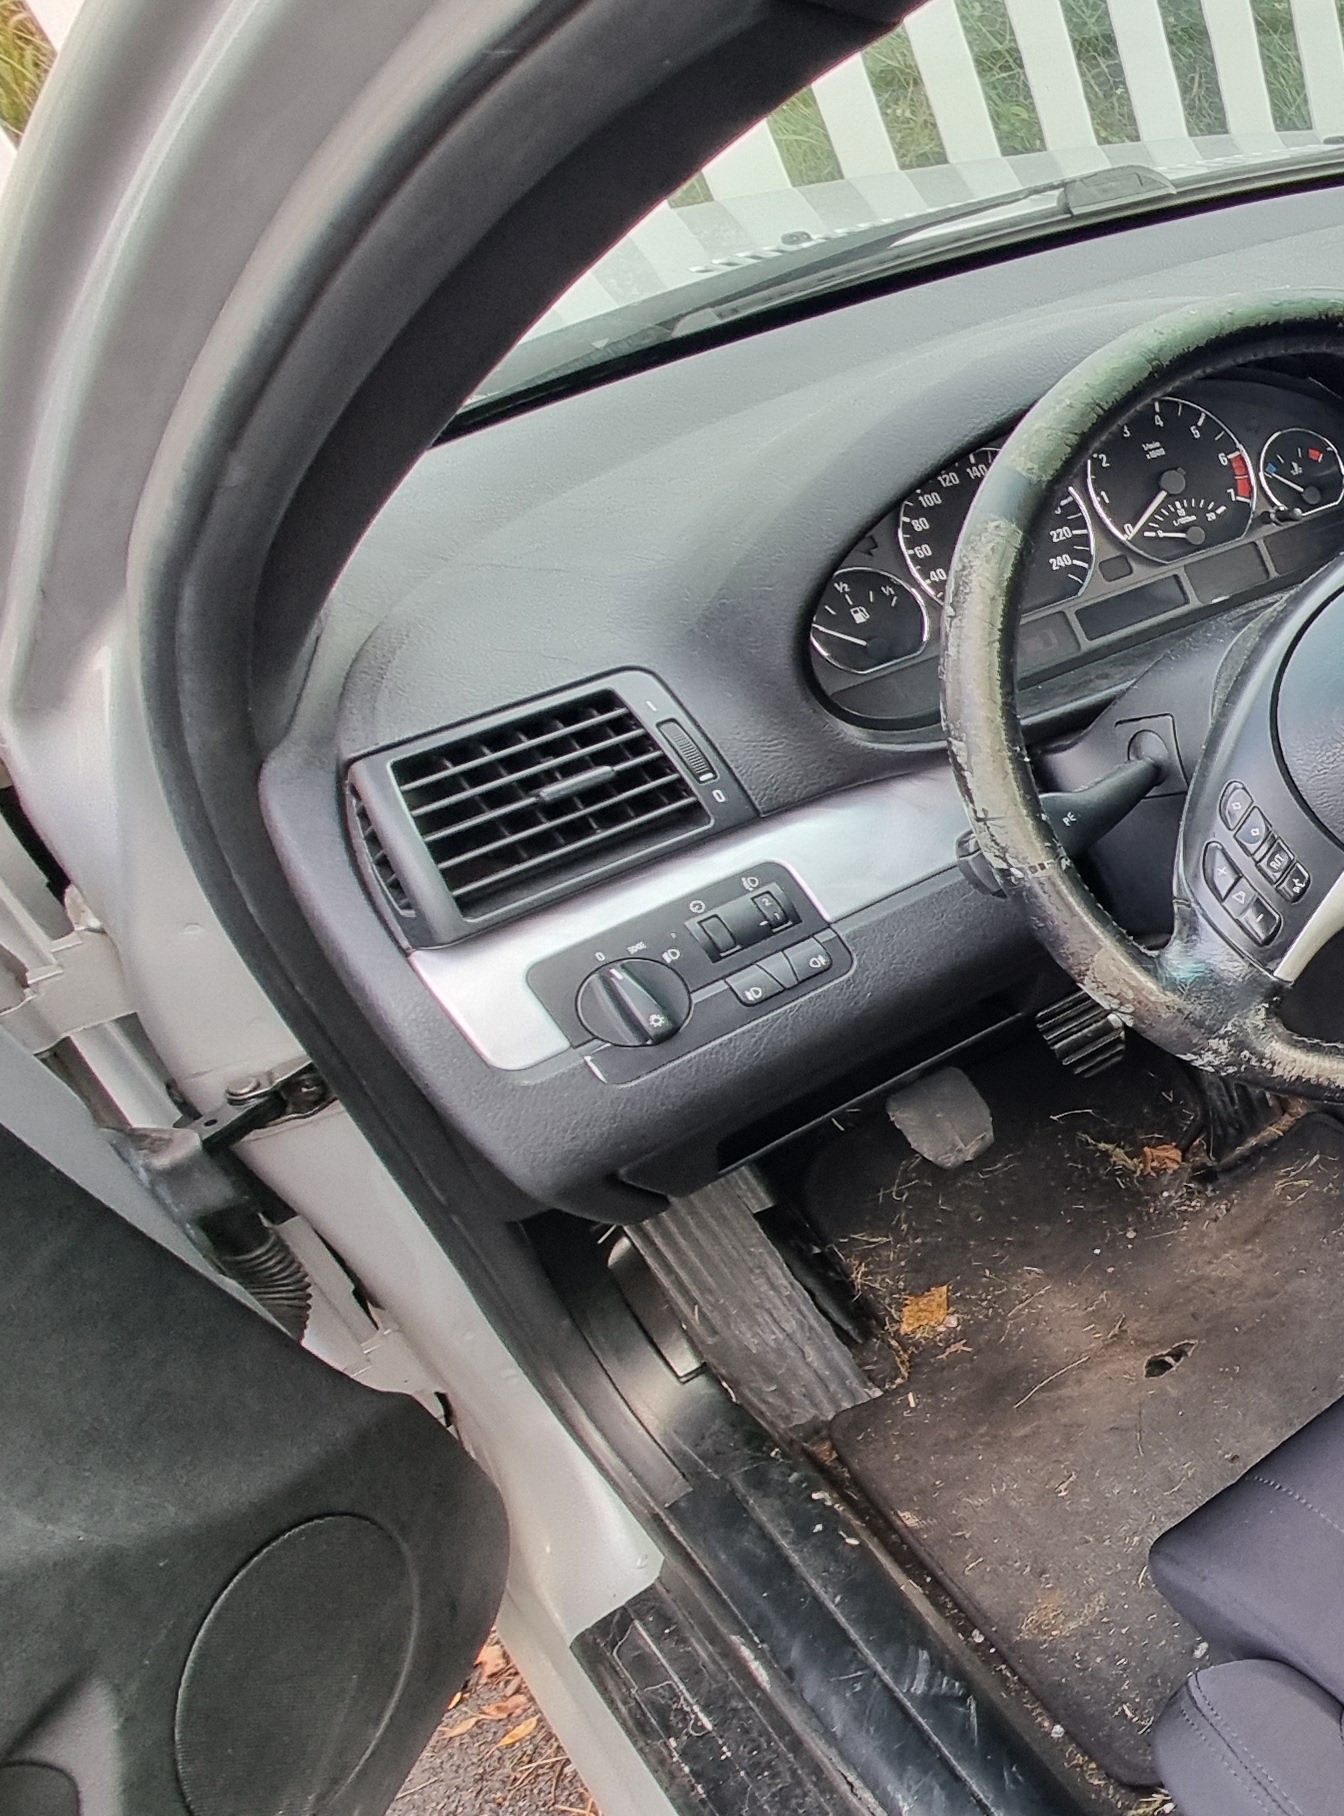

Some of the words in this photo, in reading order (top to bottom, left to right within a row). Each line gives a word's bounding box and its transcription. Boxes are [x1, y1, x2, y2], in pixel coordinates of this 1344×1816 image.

[1154, 414, 1164, 427] 4
[1123, 425, 1131, 438] 3
[1189, 425, 1201, 439] 5
[1099, 453, 1110, 467] 2
[1217, 452, 1228, 466] 6
[966, 464, 988, 480] 140
[937, 472, 960, 487] 120
[918, 492, 942, 508] 100
[1100, 490, 1110, 503] 1
[1226, 488, 1236, 501] 7
[911, 517, 930, 532] 80
[1049, 526, 1073, 543] 220
[914, 543, 932, 559] 60
[1049, 554, 1072, 571] 240
[929, 568, 947, 582] 40
